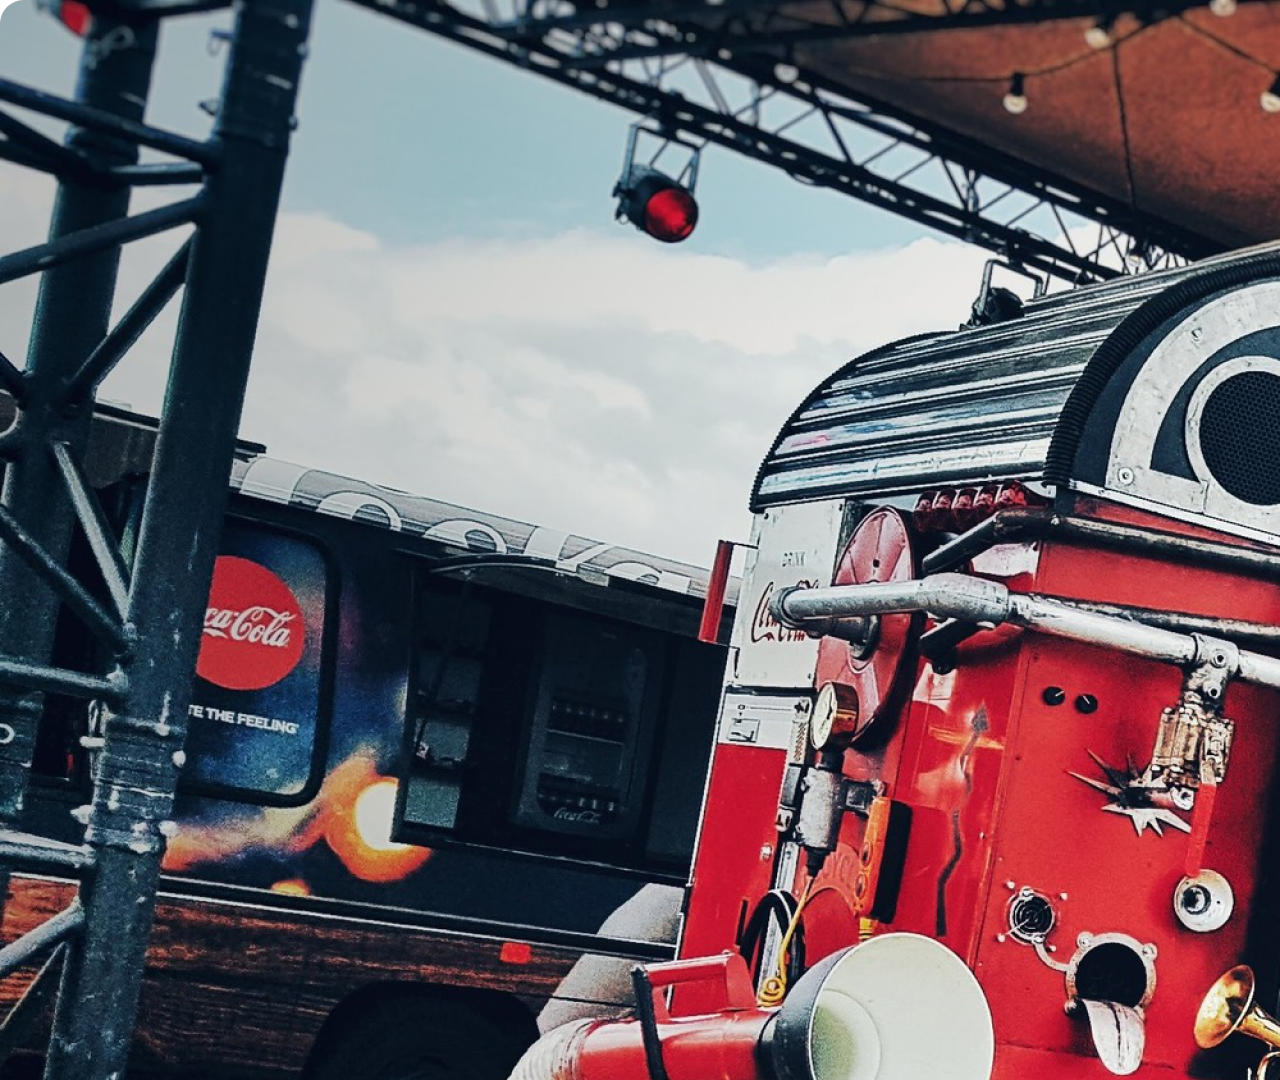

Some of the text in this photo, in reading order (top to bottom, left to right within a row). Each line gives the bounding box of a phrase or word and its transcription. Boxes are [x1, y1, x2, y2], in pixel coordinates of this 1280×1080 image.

[203, 606, 297, 647] ca-Cola
[206, 708, 234, 724] THE
[237, 713, 299, 734] FEELING
